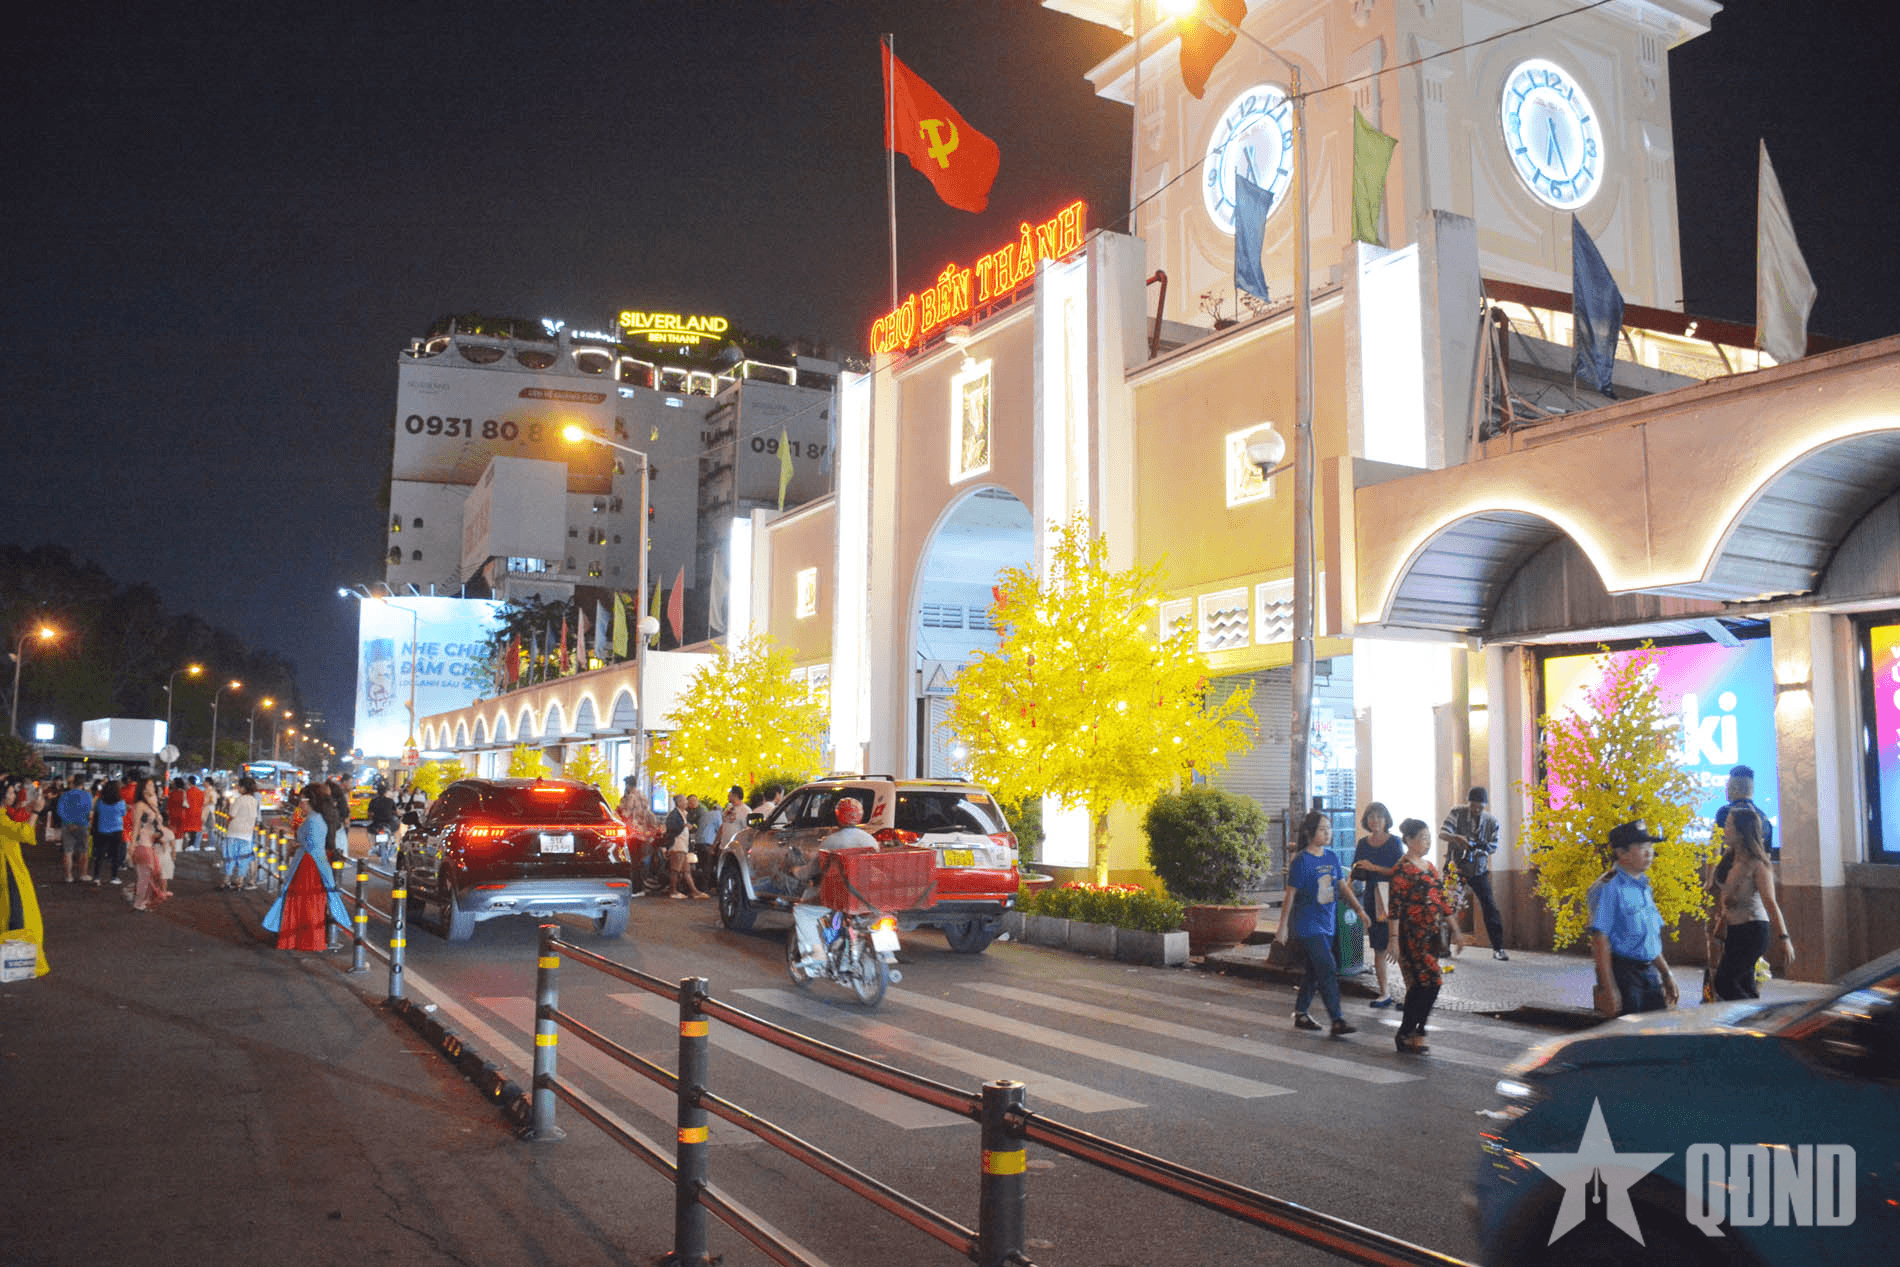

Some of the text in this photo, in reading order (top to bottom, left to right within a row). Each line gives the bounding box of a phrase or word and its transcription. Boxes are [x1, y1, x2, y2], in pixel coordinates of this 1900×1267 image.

[869, 200, 1085, 355] CHỢ BẾN THÀNH
[619, 310, 729, 333] SILVERLAND
[664, 333, 700, 345] THANH
[404, 414, 473, 438] 0931
[481, 419, 520, 442] 80
[751, 436, 801, 458] 091
